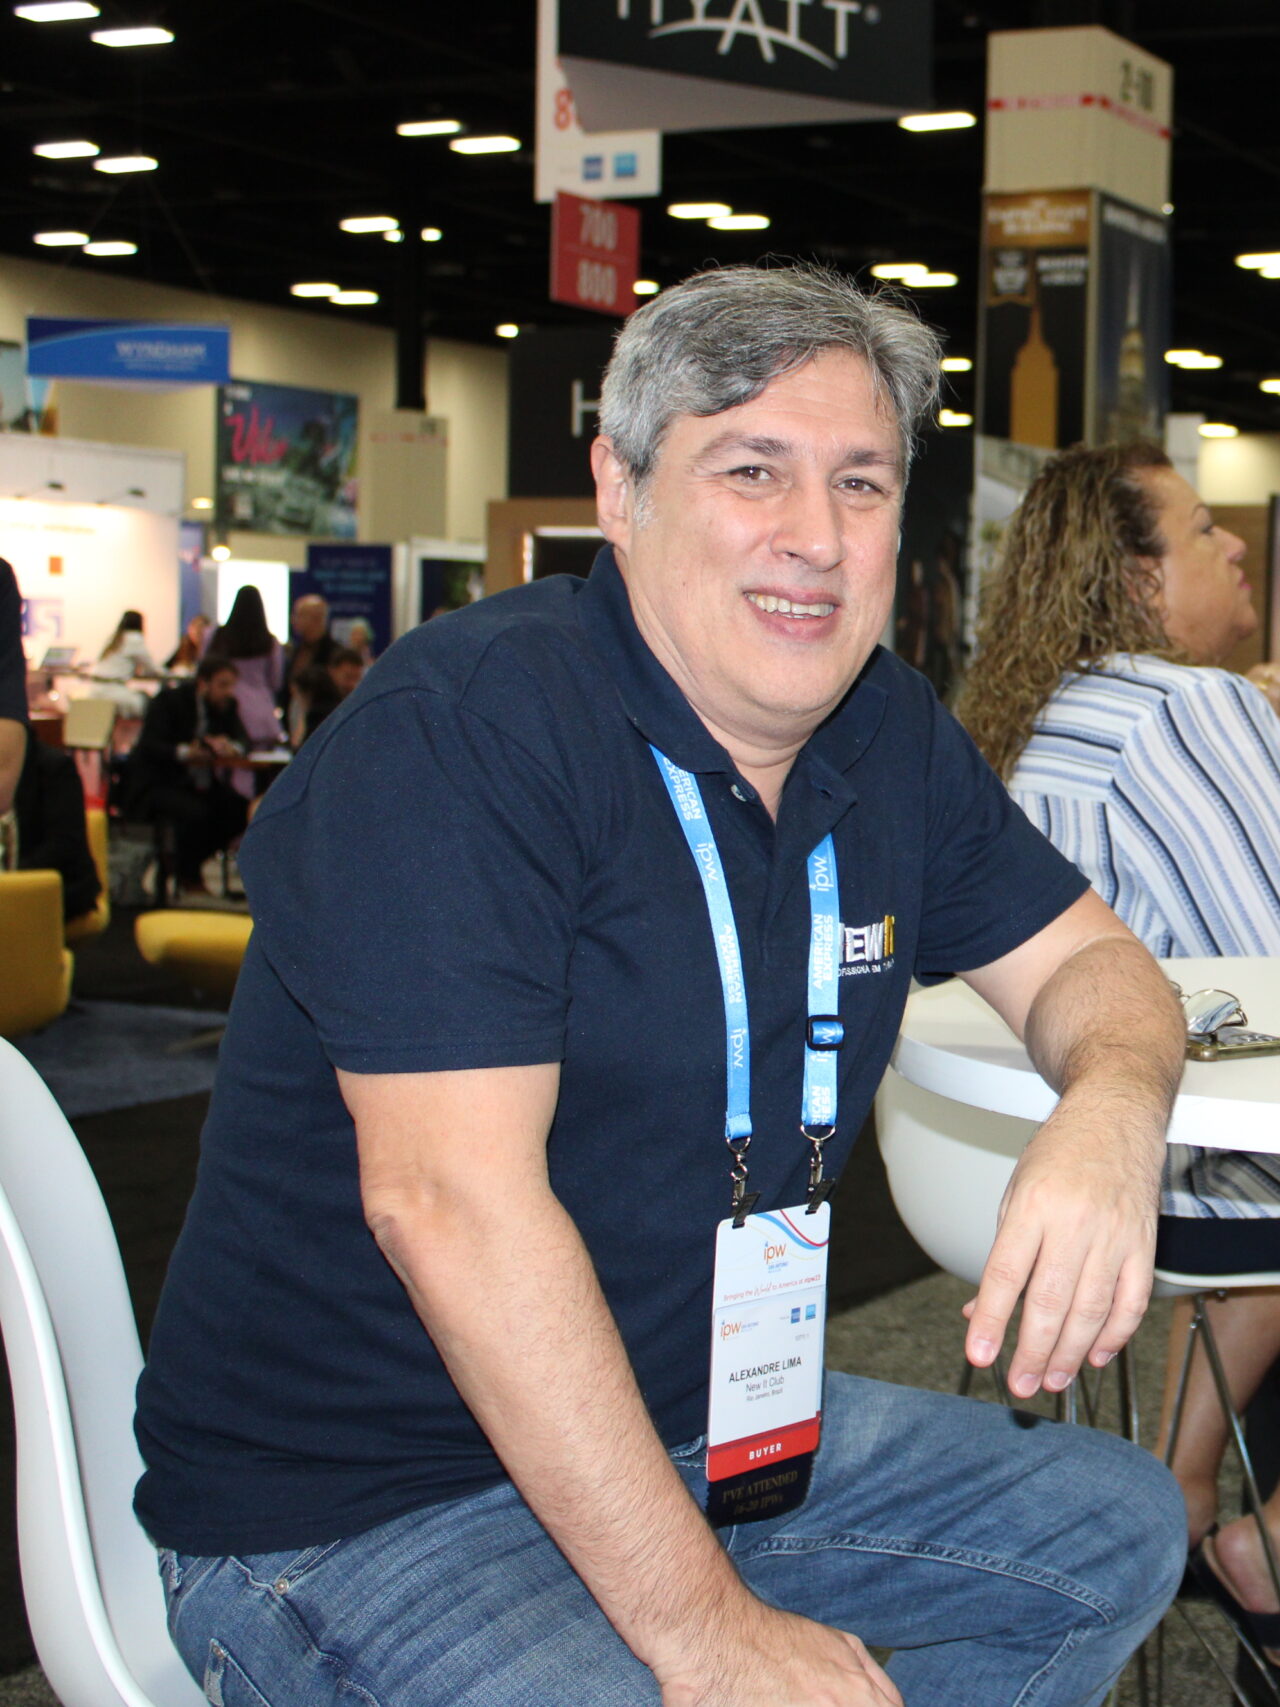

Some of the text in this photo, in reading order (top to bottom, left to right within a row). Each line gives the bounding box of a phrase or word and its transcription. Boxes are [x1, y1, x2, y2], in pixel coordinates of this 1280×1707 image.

[678, 769, 703, 820] ERICAN
[695, 842, 718, 881] ipw
[809, 855, 834, 892] ipw
[813, 914, 824, 990] AMERICAN
[823, 915, 834, 981] EXPRESS
[730, 1028, 747, 1069] ipw
[763, 1241, 787, 1265] ipw
[721, 1320, 742, 1341] ipw
[728, 1356, 802, 1384] ALEXANDRE LIMA
[745, 1382, 761, 1393] New
[769, 1374, 785, 1388] Club
[749, 1443, 782, 1460] BUYER
